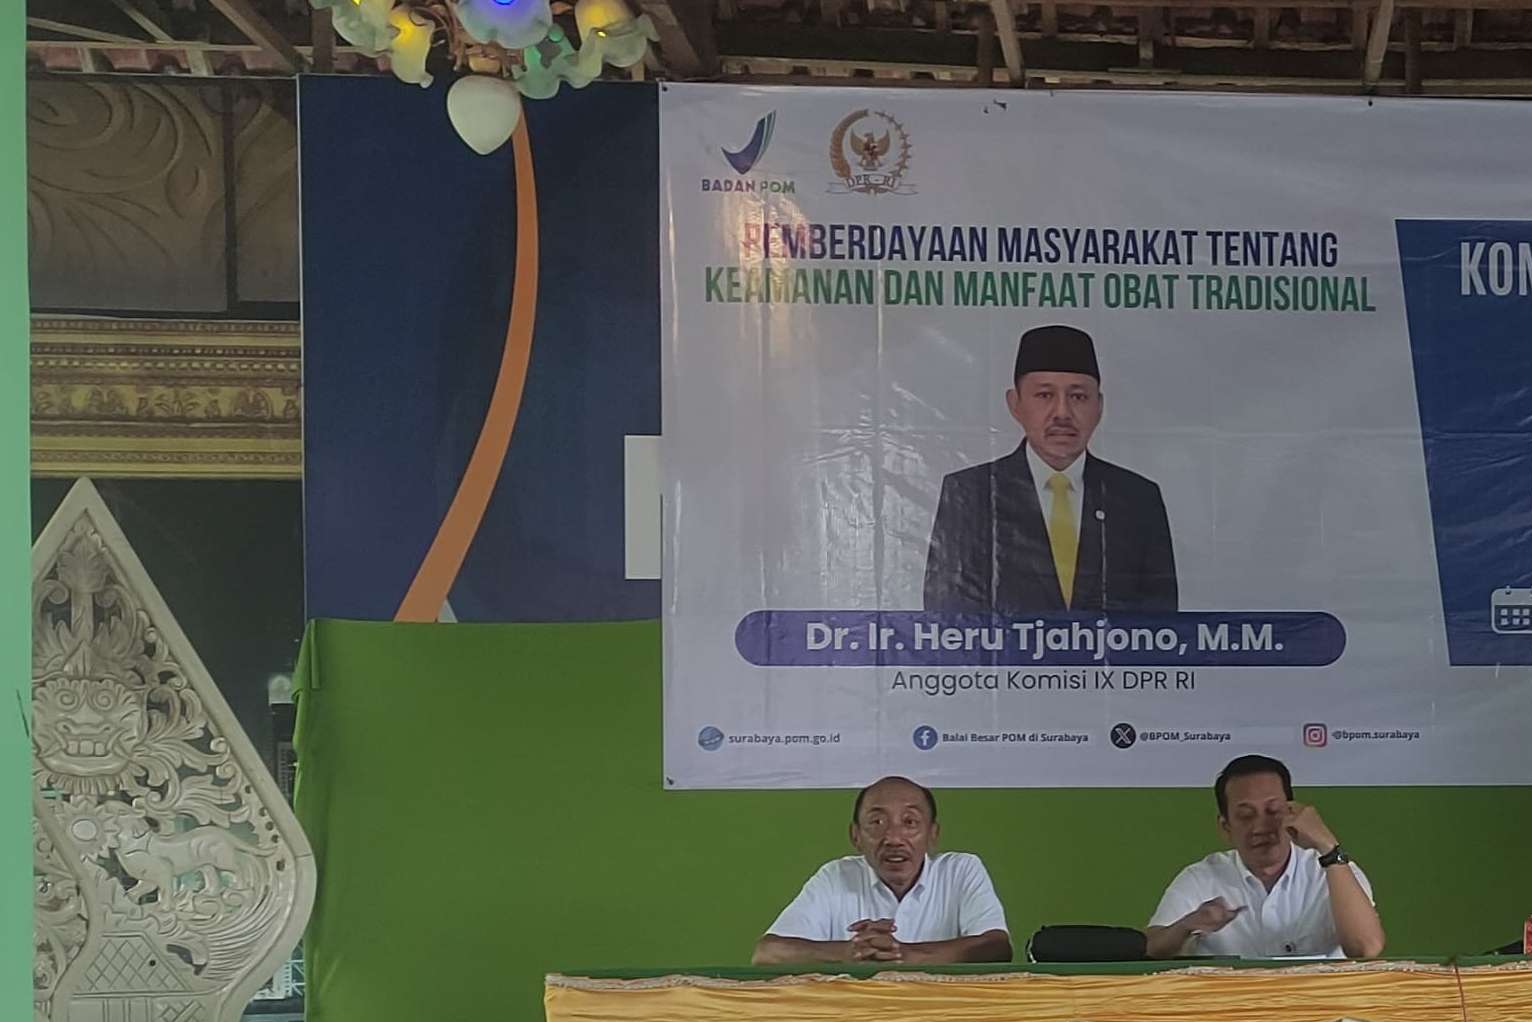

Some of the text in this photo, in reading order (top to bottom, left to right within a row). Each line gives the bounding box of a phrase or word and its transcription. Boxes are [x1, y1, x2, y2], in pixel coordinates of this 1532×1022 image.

[702, 178, 796, 194] BADAN POM
[743, 222, 1339, 268] PEMBERDAYAAN MASYARAKAT TENTANG
[704, 266, 1377, 313] KEAMANAN DAN MANFAAT OBAT TRADISIONAL
[806, 620, 1284, 660] Dr. Ir. Heru Tjahjono, M.M.
[891, 670, 1196, 697] Anggota Komisi IX DPR RI
[728, 732, 841, 746] surabaya.pom.go.id
[942, 733, 1089, 744] Balai Besar POM di Surabaya
